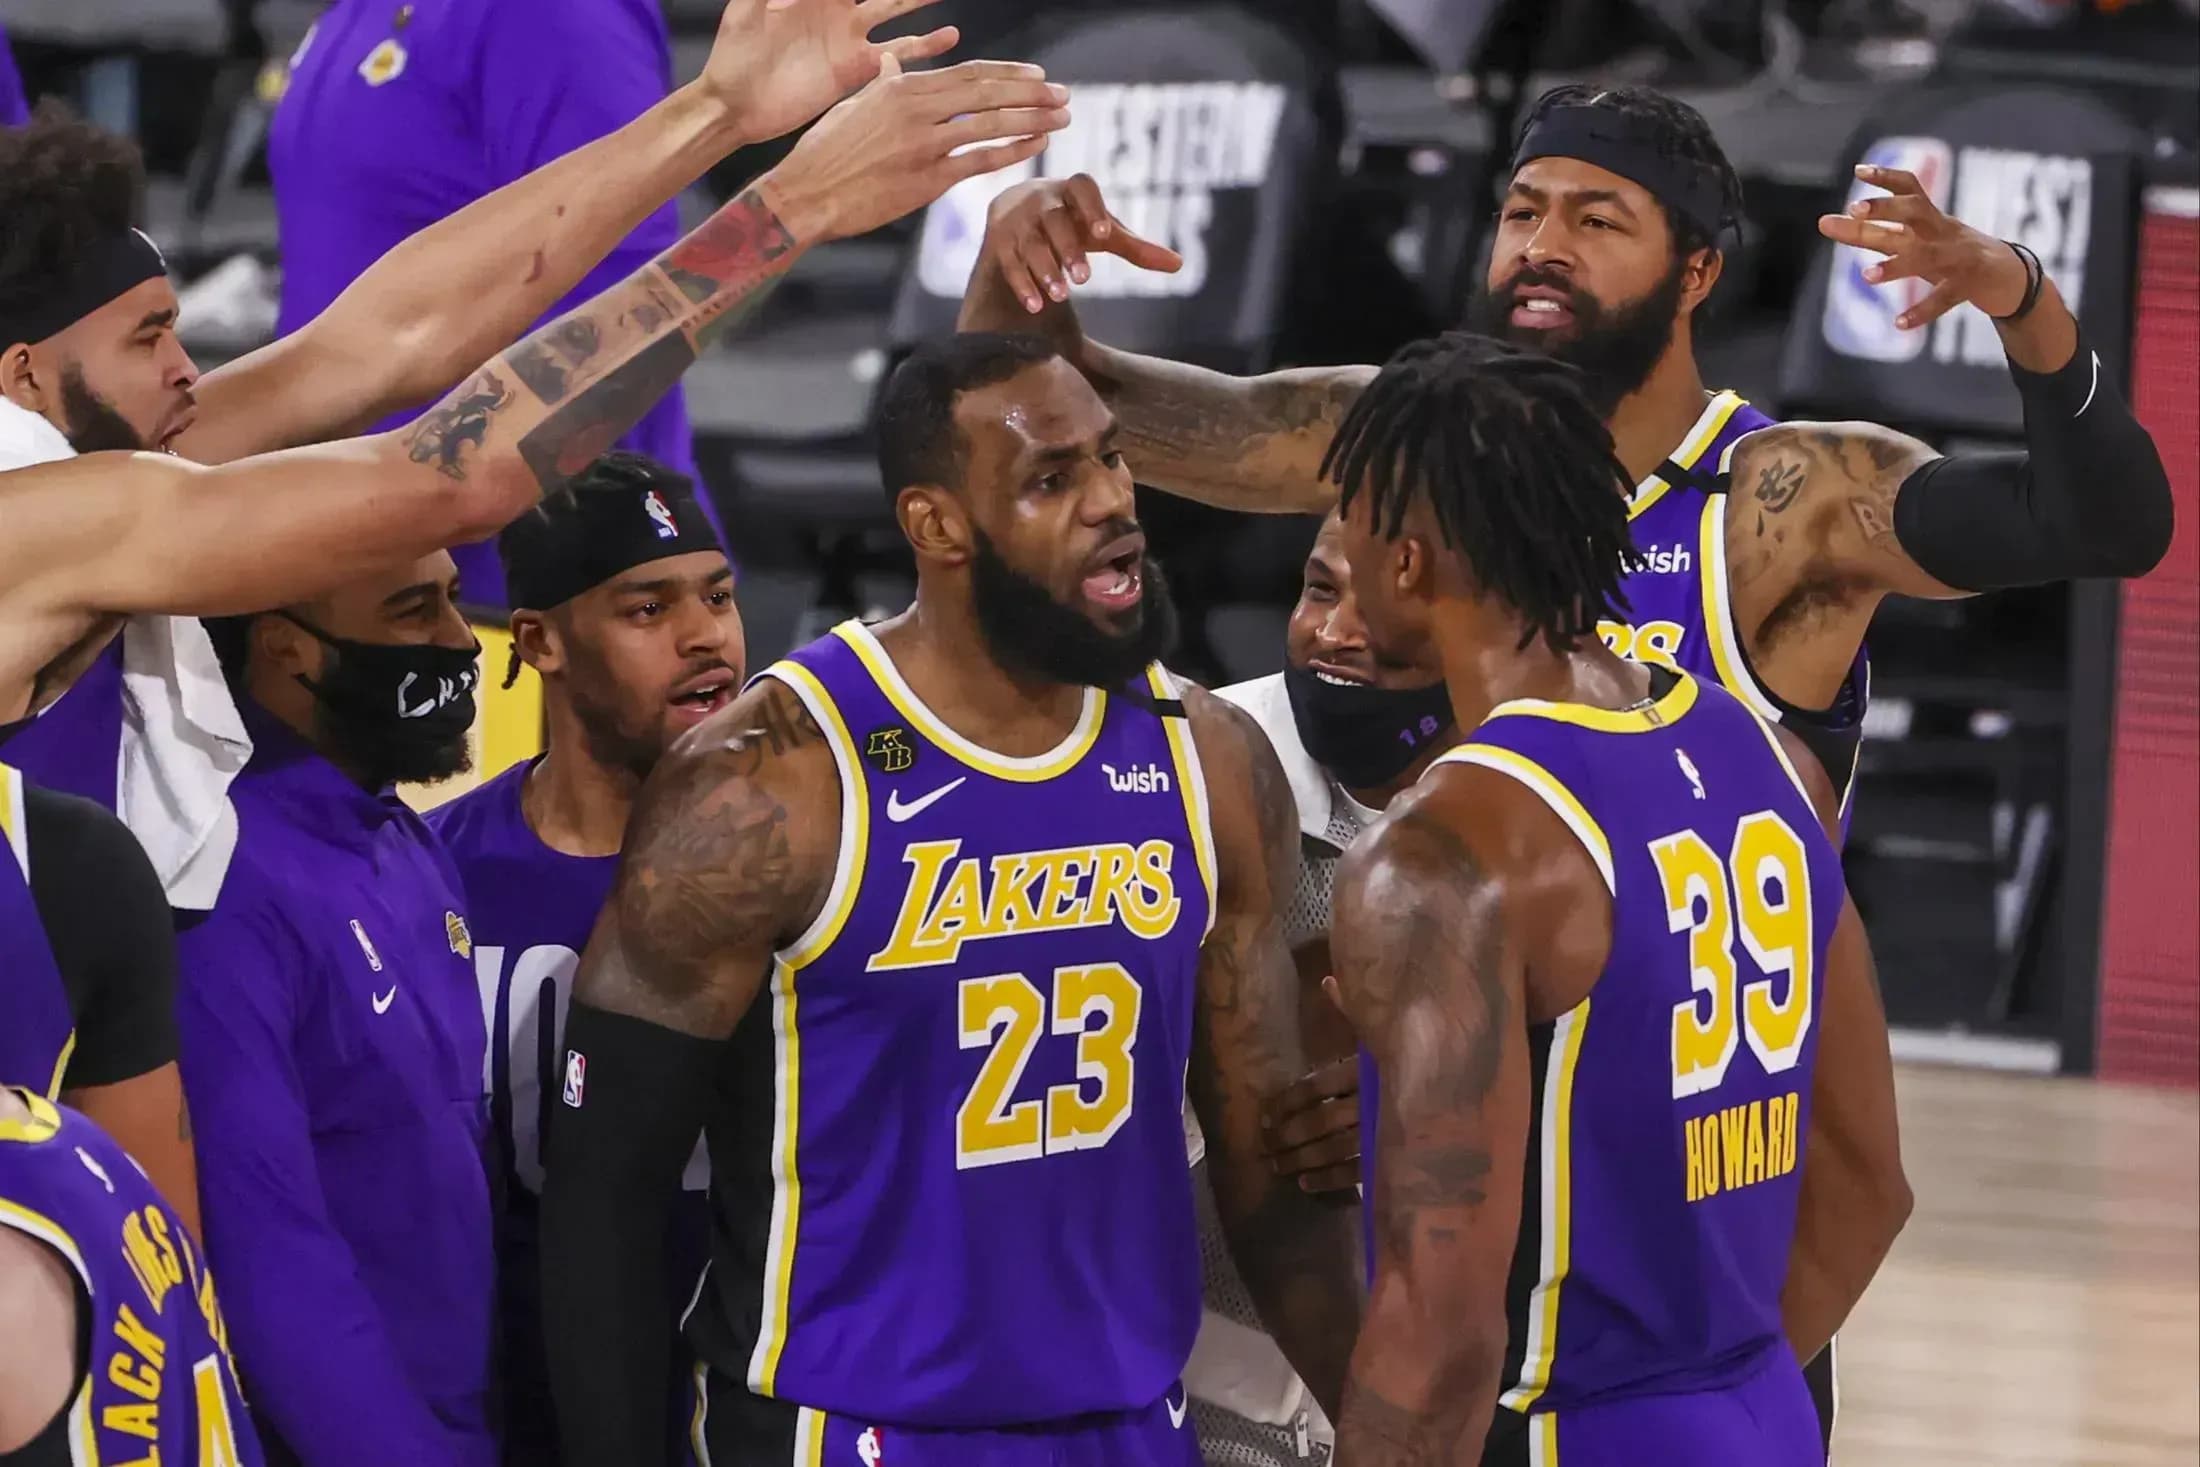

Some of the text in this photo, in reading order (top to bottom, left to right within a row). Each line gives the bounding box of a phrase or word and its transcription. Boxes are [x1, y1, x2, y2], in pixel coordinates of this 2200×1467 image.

[864, 838, 1181, 973] LAKERS
[1647, 809, 1814, 1100] 39
[956, 961, 1142, 1171] 23
[1684, 1092, 1799, 1203] HOWARD
